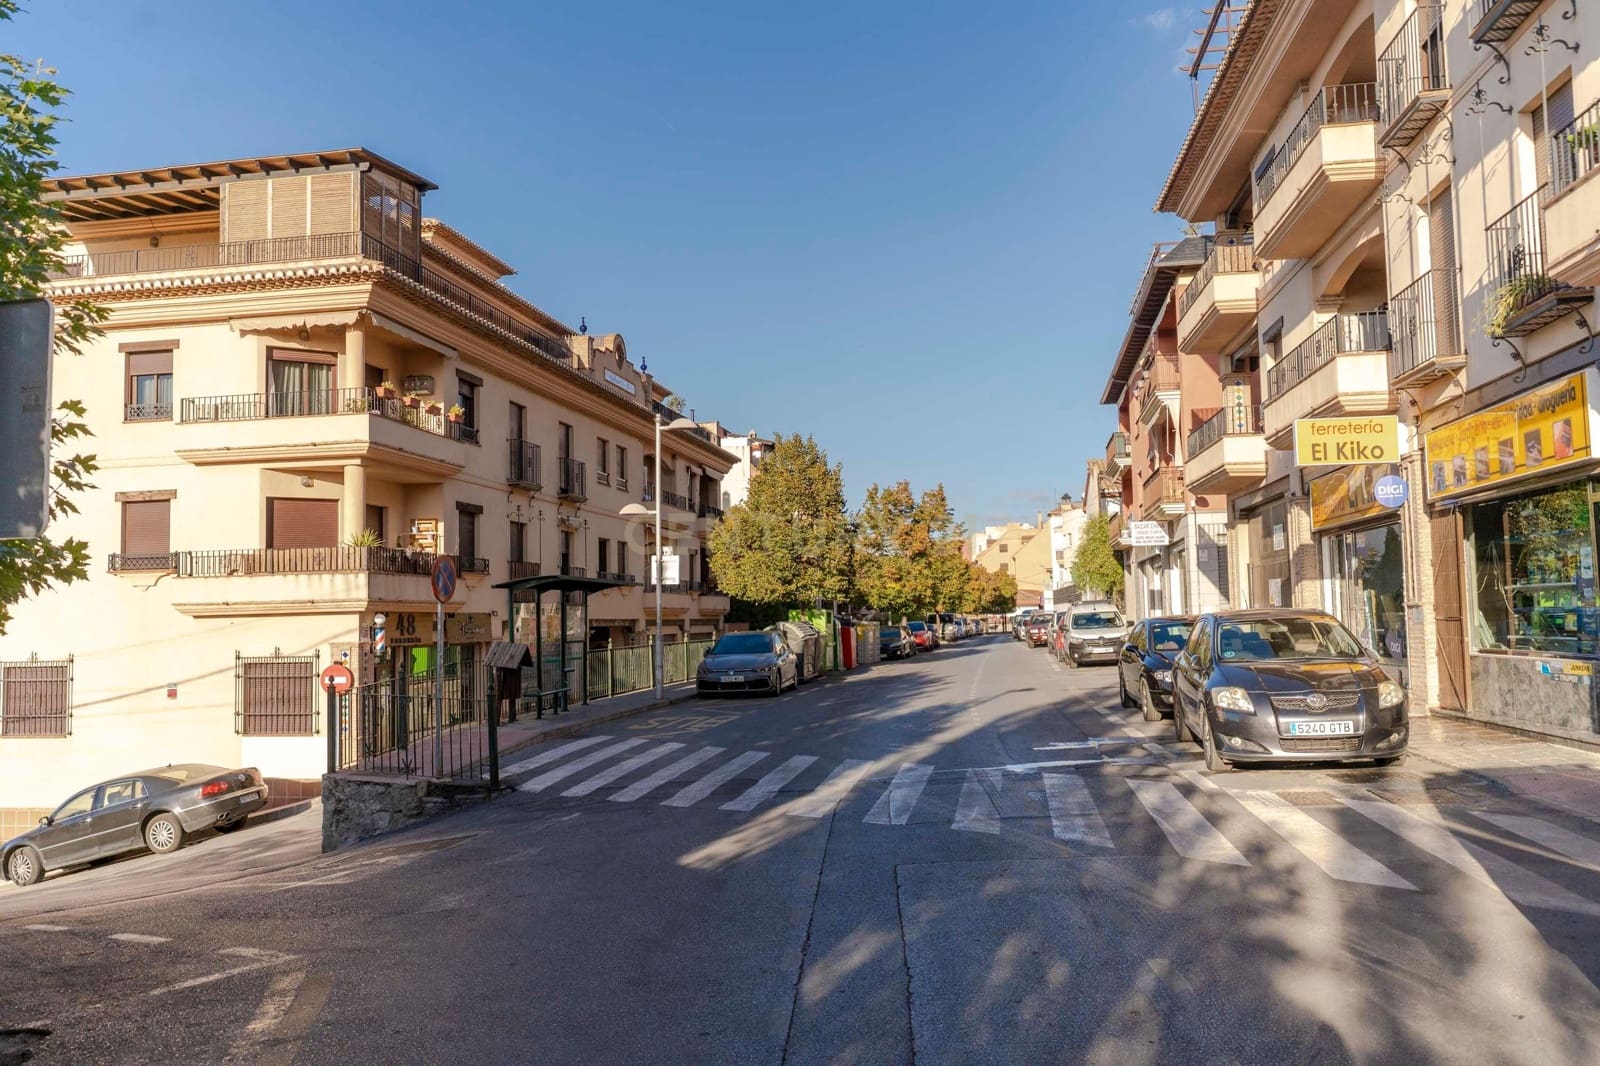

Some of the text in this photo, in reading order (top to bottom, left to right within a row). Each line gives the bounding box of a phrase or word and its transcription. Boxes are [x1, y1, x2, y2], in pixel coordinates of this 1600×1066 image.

[1311, 419, 1384, 436] ferretería
[1311, 440, 1385, 462] El Kiko
[1377, 484, 1404, 495] DIGI
[396, 613, 415, 635] 48
[1297, 721, 1351, 735] 5240 GTB
